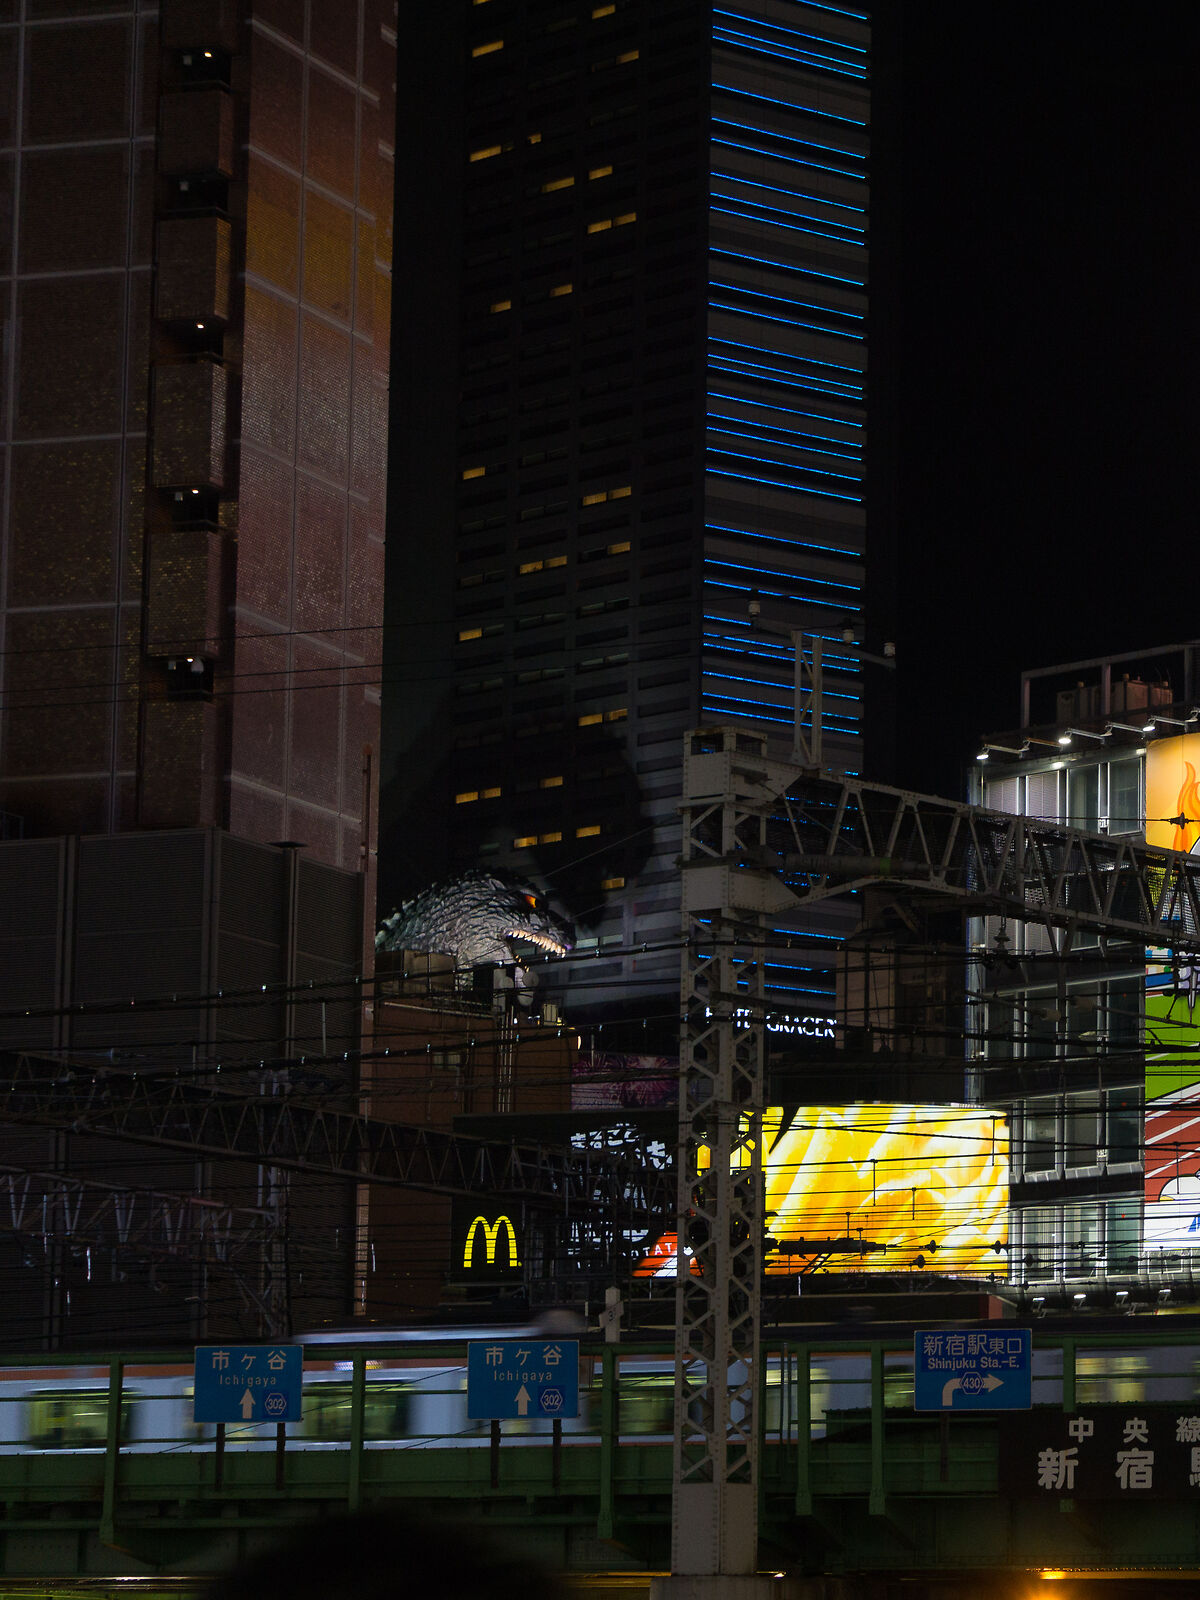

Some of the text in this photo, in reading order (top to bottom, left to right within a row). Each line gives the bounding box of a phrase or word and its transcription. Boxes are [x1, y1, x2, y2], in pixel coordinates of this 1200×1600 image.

[923, 1334, 1022, 1356] 新宿駅東口
[928, 1358, 976, 1371] Shinjuku
[219, 1374, 277, 1388] Ichigaya
[493, 1370, 552, 1384] Ichigaya
[963, 1377, 981, 1389] 430
[267, 1398, 284, 1410] 302
[543, 1394, 560, 1406] 302
